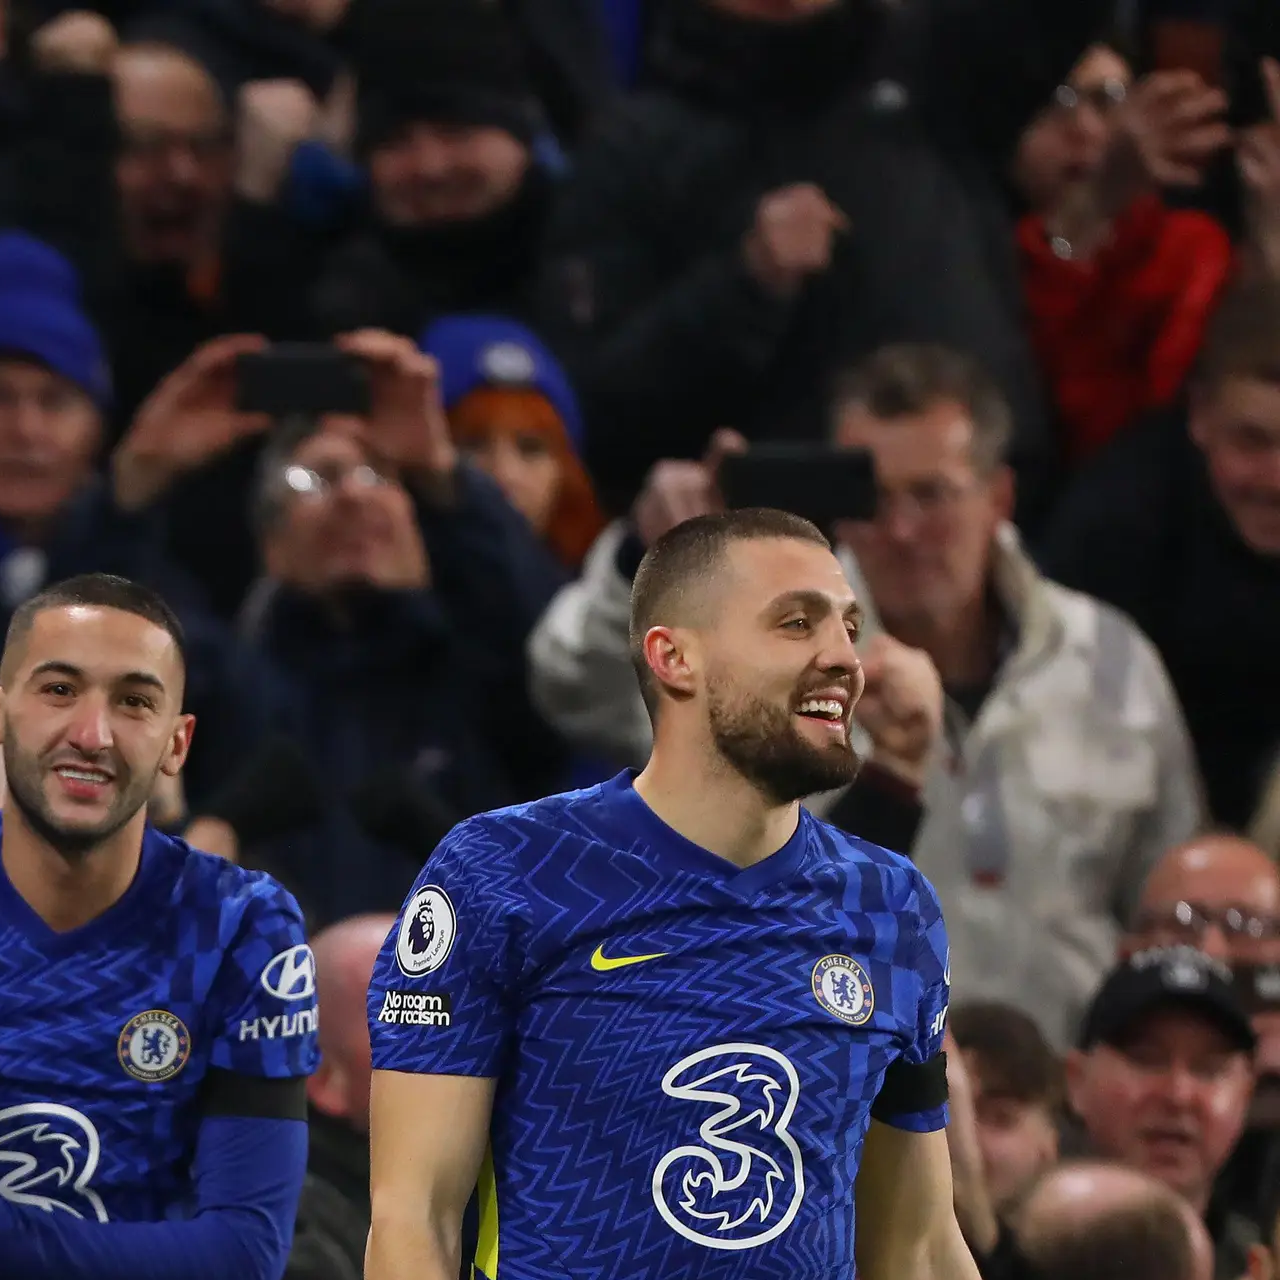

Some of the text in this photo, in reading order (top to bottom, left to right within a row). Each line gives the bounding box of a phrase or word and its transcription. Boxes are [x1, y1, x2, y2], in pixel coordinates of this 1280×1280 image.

[413, 929, 445, 968] Premier League
[821, 957, 861, 977] CHELSEA
[384, 991, 442, 1011] No room
[133, 1013, 179, 1029] CHELSEA
[378, 1006, 450, 1026] For racism
